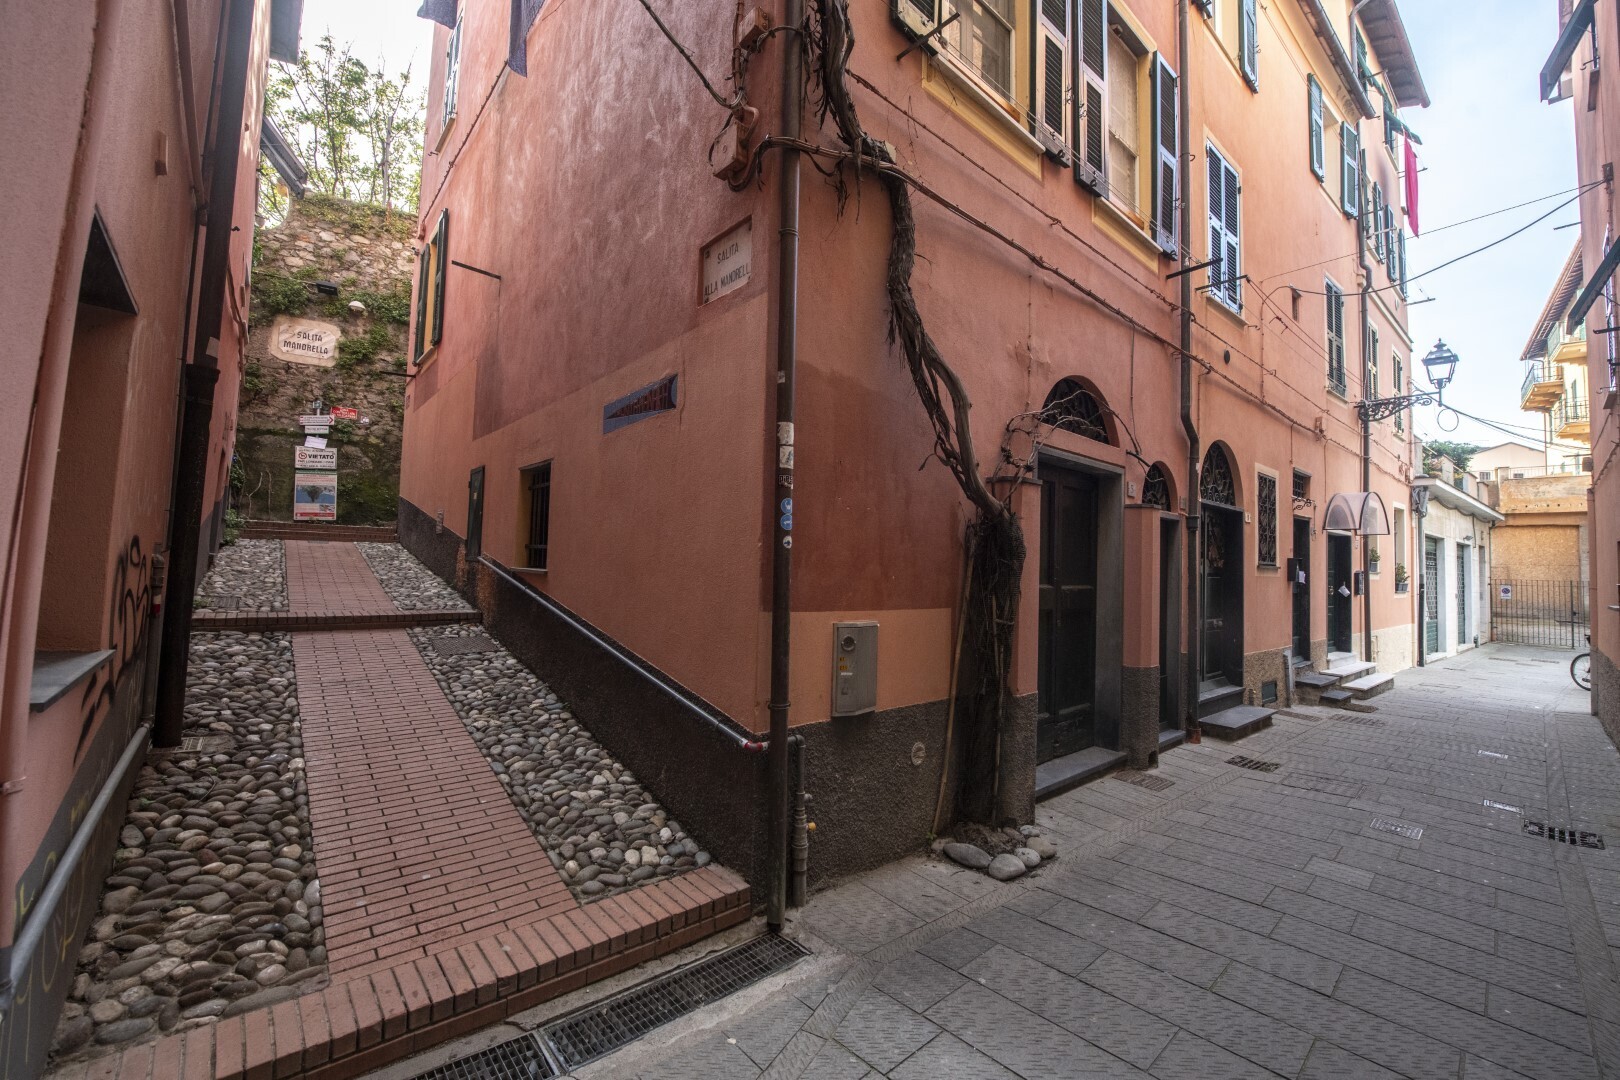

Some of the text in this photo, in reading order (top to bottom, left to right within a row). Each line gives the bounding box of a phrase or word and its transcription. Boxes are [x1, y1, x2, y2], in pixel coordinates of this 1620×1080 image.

[717, 242, 739, 265] SALITA
[296, 331, 323, 342] SALITA
[283, 340, 329, 355] MANDRELLA
